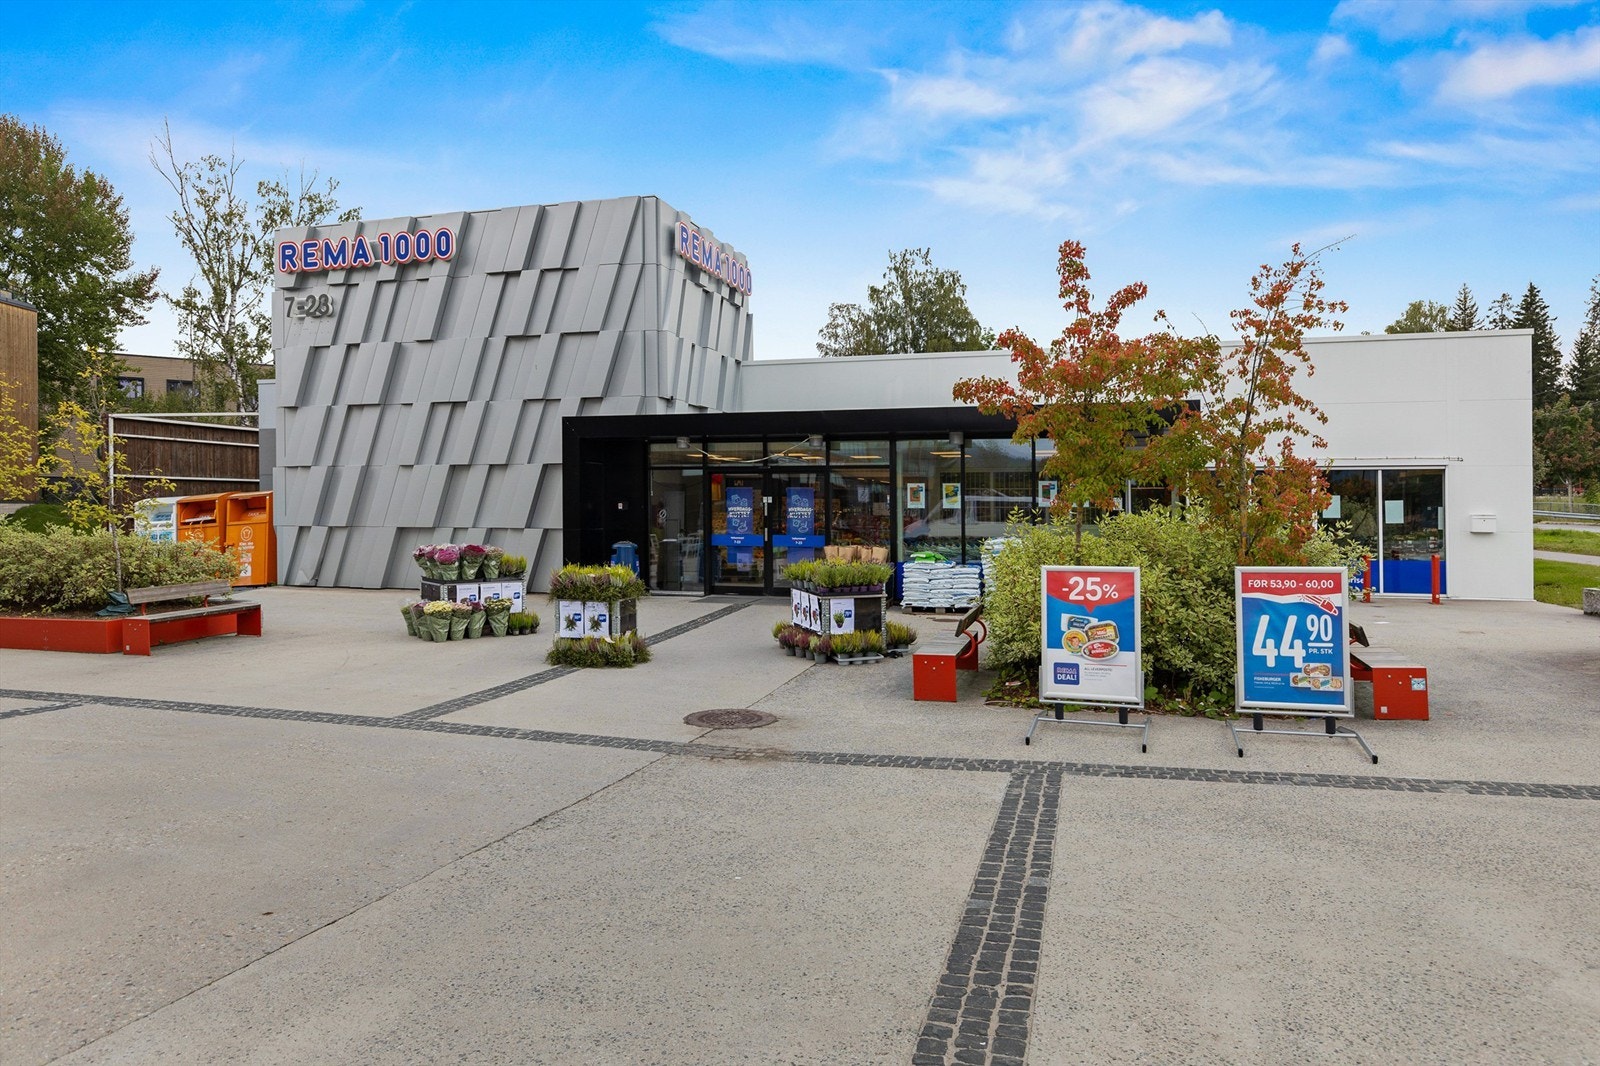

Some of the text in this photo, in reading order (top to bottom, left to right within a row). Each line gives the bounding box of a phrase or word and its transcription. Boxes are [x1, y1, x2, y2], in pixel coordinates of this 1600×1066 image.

[279, 227, 456, 273] REMA 1000
[678, 220, 752, 296] REMA 1000
[1062, 576, 1119, 601] -25%
[1248, 579, 1268, 588] FØR
[1270, 579, 1297, 589] 53,90
[1305, 579, 1334, 589] 60,00
[1252, 614, 1333, 669] 44 90
[1057, 673, 1077, 681] DEAL!
